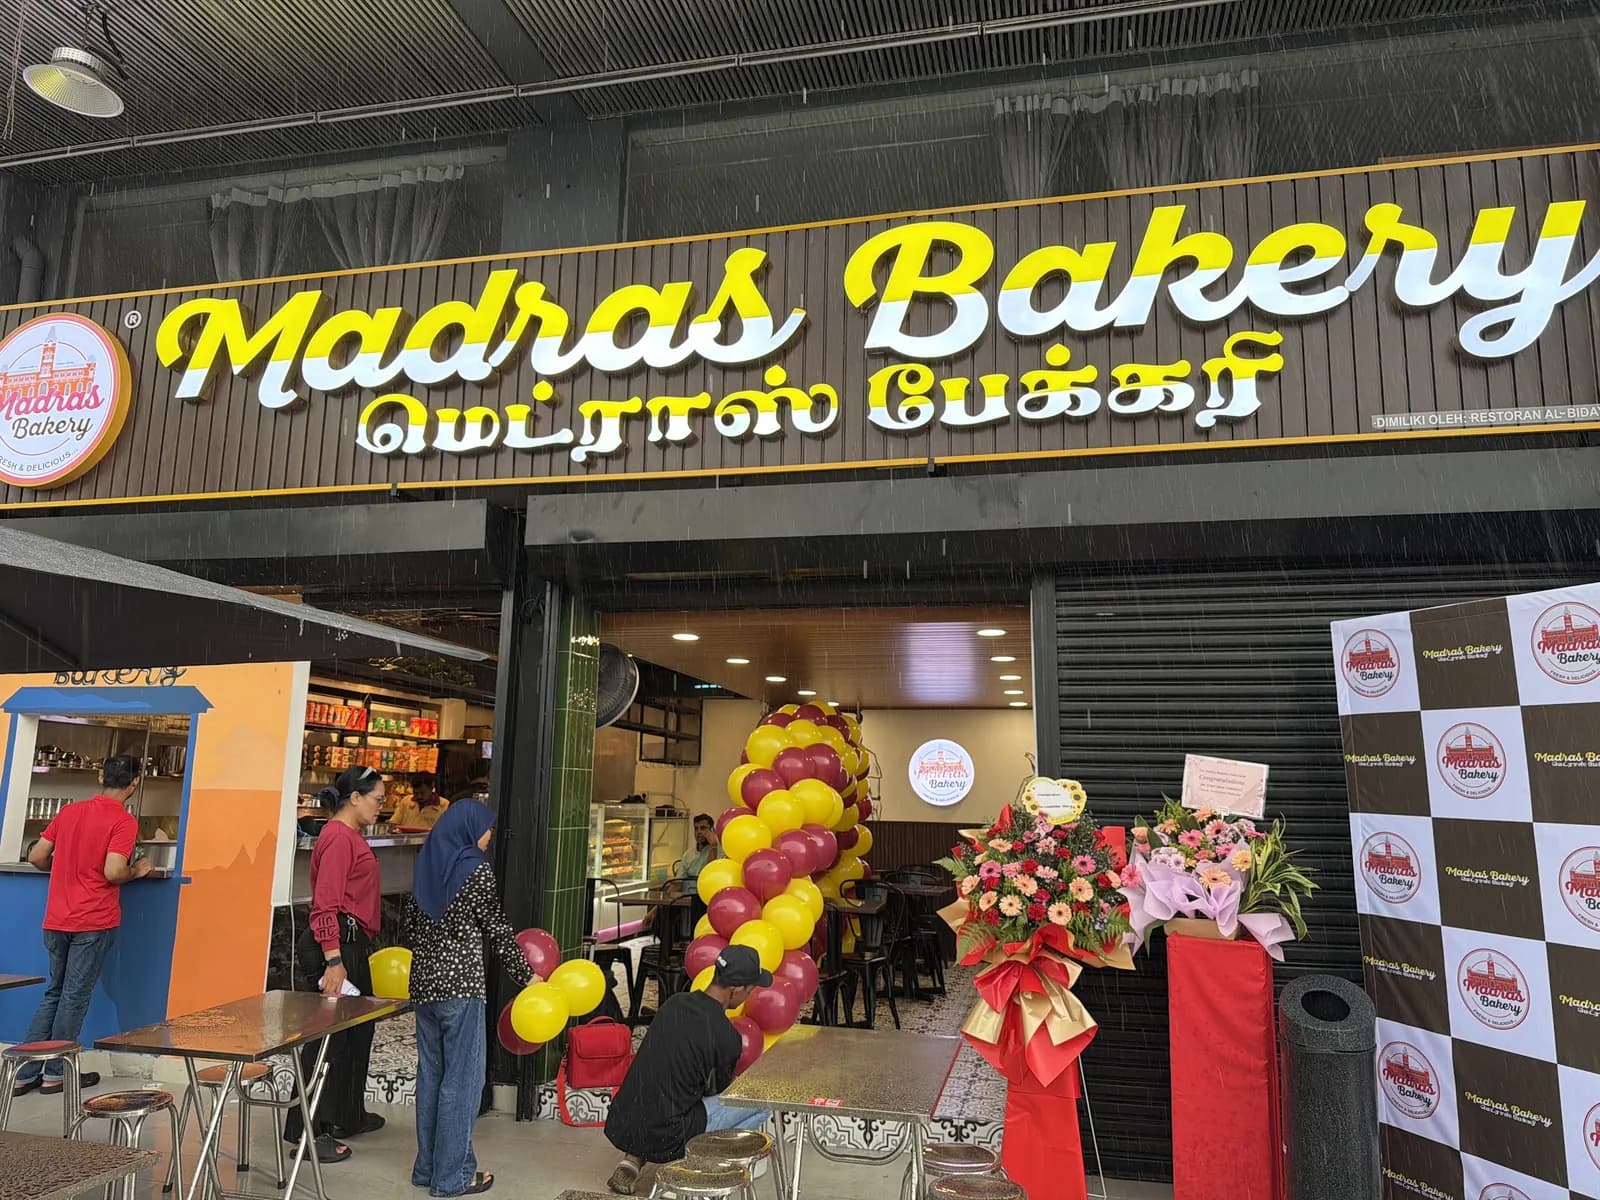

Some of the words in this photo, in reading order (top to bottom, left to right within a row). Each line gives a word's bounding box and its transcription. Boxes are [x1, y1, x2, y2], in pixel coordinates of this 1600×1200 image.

[157, 248, 806, 409] Madras
[844, 200, 1600, 359] Bakery
[356, 364, 839, 463] மெட்ராஸ்
[867, 330, 1285, 430] பேக்கரி
[12, 416, 93, 441] Bakery
[1422, 647, 1464, 659] Madras
[1465, 644, 1503, 655] Bakery
[1537, 639, 1600, 655] Madra
[1346, 656, 1396, 673] Madras
[1360, 670, 1394, 682] Bakery
[1344, 754, 1382, 763] Madras
[1382, 753, 1416, 765] Bakery
[1442, 755, 1502, 769] Madras
[1534, 752, 1583, 763] Madras
[1459, 769, 1499, 783] Bakery
[929, 779, 967, 791] Bakery
[1365, 861, 1417, 877] Madras
[1445, 866, 1488, 879] Madras
[1490, 870, 1530, 886] Bakery
[1379, 874, 1414, 890] Bakery
[1363, 956, 1400, 970] Madras
[1401, 962, 1437, 980] Bakery
[1463, 979, 1525, 1002] Madras
[1481, 996, 1522, 1016] Bakery
[1383, 1067, 1436, 1095] Madras
[1398, 1085, 1432, 1107] Bakery
[1464, 1091, 1510, 1113] Madras
[1511, 1105, 1552, 1127] Bakery
